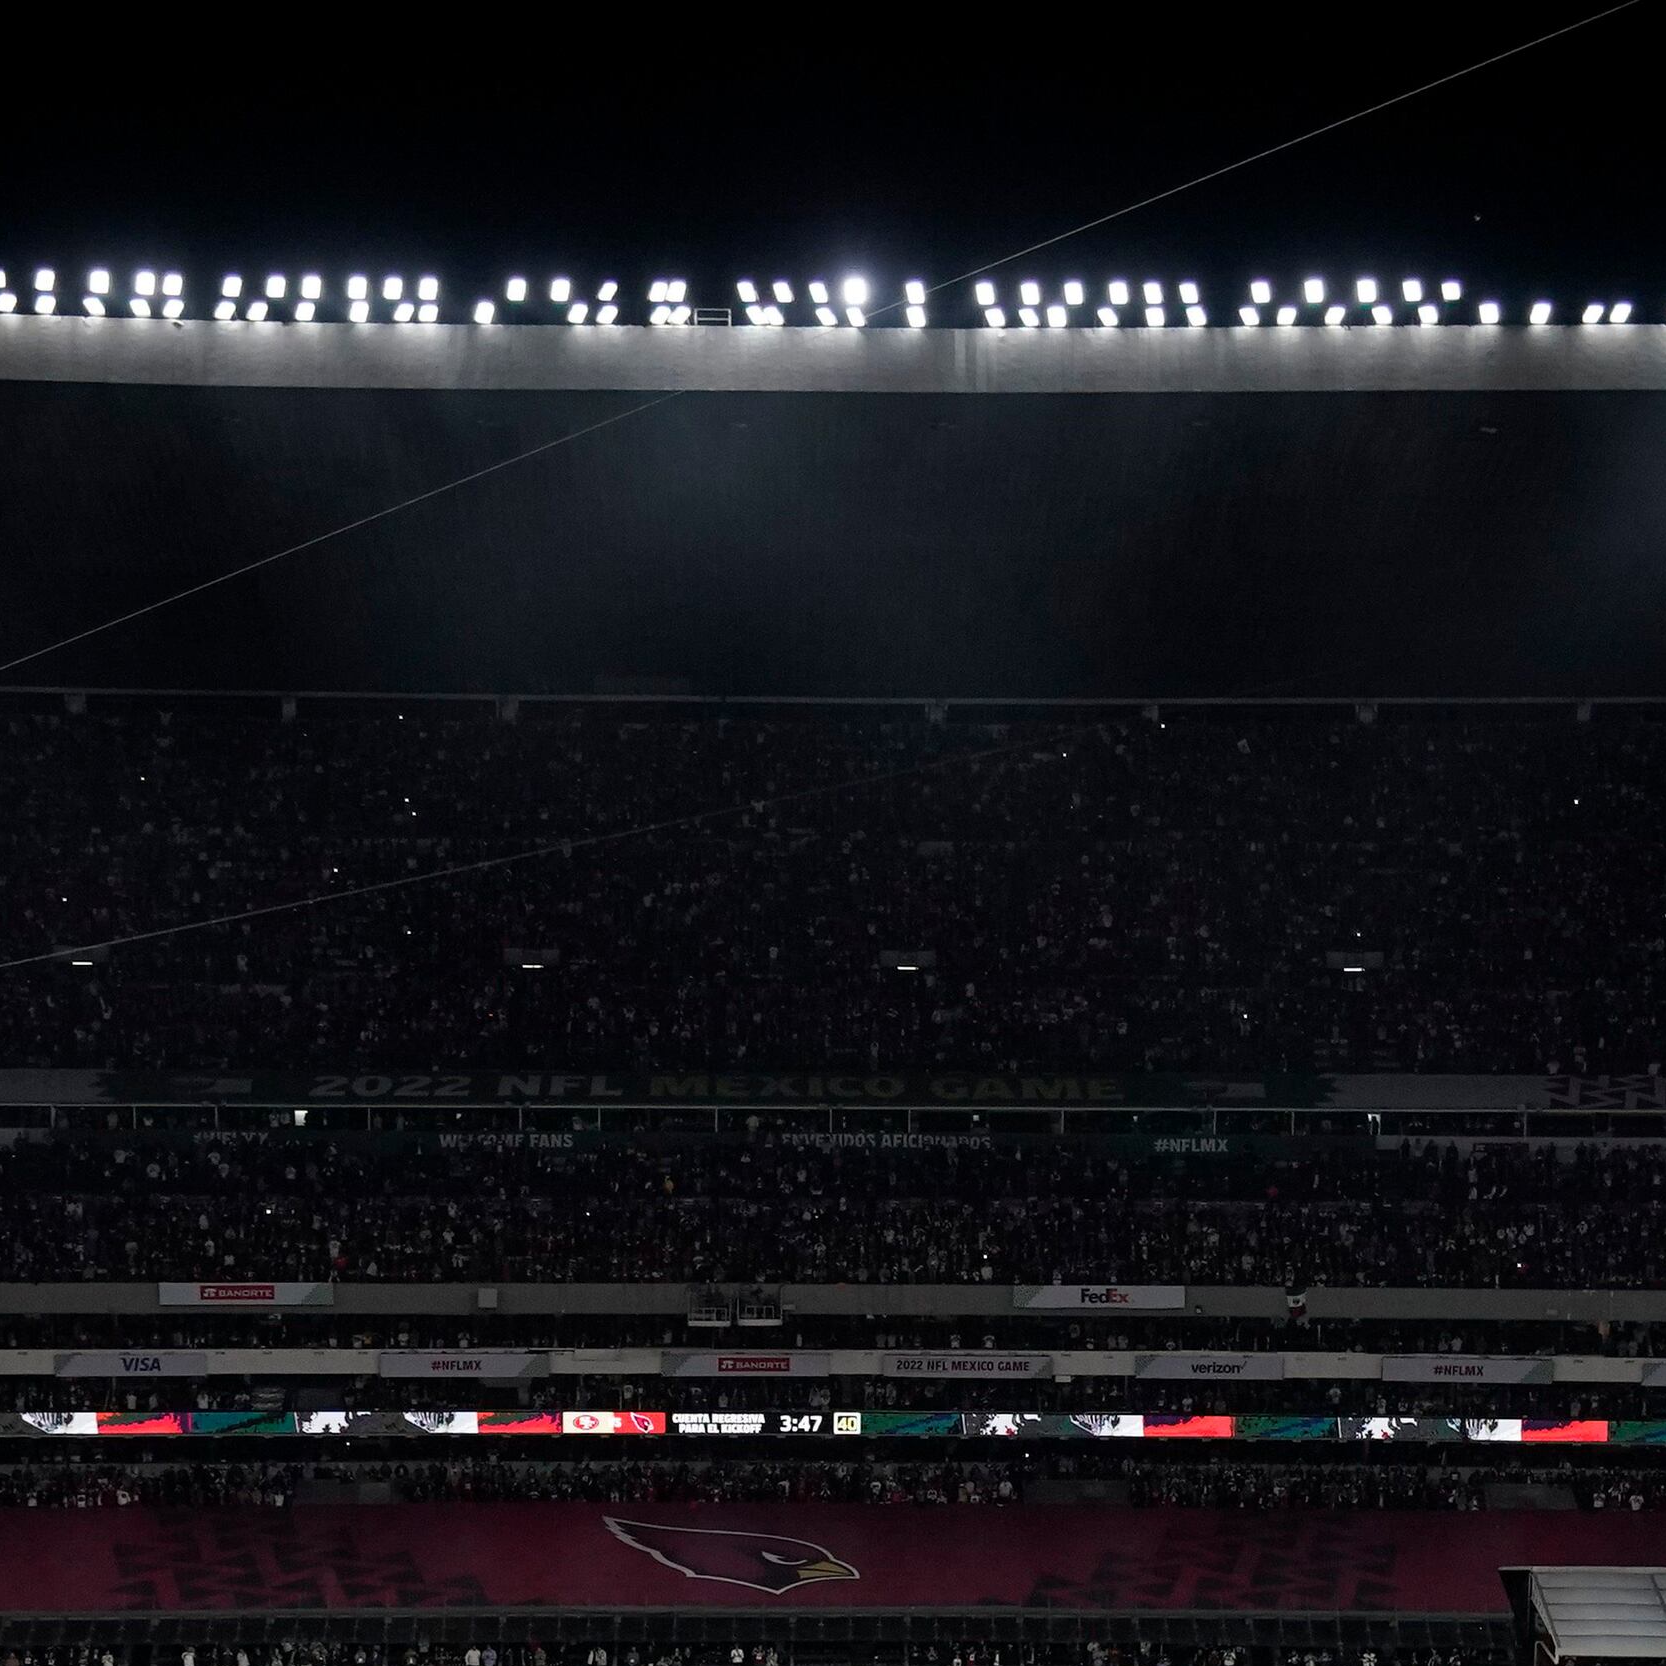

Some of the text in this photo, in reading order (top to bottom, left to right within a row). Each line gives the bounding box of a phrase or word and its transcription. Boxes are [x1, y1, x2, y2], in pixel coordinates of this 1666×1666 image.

[218, 1289, 273, 1298] BANORTE
[1081, 1288, 1129, 1303] FedEx
[123, 1357, 161, 1371] VISA
[431, 1360, 481, 1371] #NFLMX
[736, 1360, 789, 1370] BANORTE
[896, 1360, 1030, 1372] 2022 NFL MEXICO GAME
[1191, 1361, 1242, 1374] verizon
[1433, 1365, 1483, 1377] #NFLMX
[672, 1413, 765, 1424] CUENTA REGRESIVA
[779, 1415, 823, 1432] 3:47
[837, 1416, 857, 1432] 40
[679, 1424, 761, 1434] PARA EL KICKOFF
